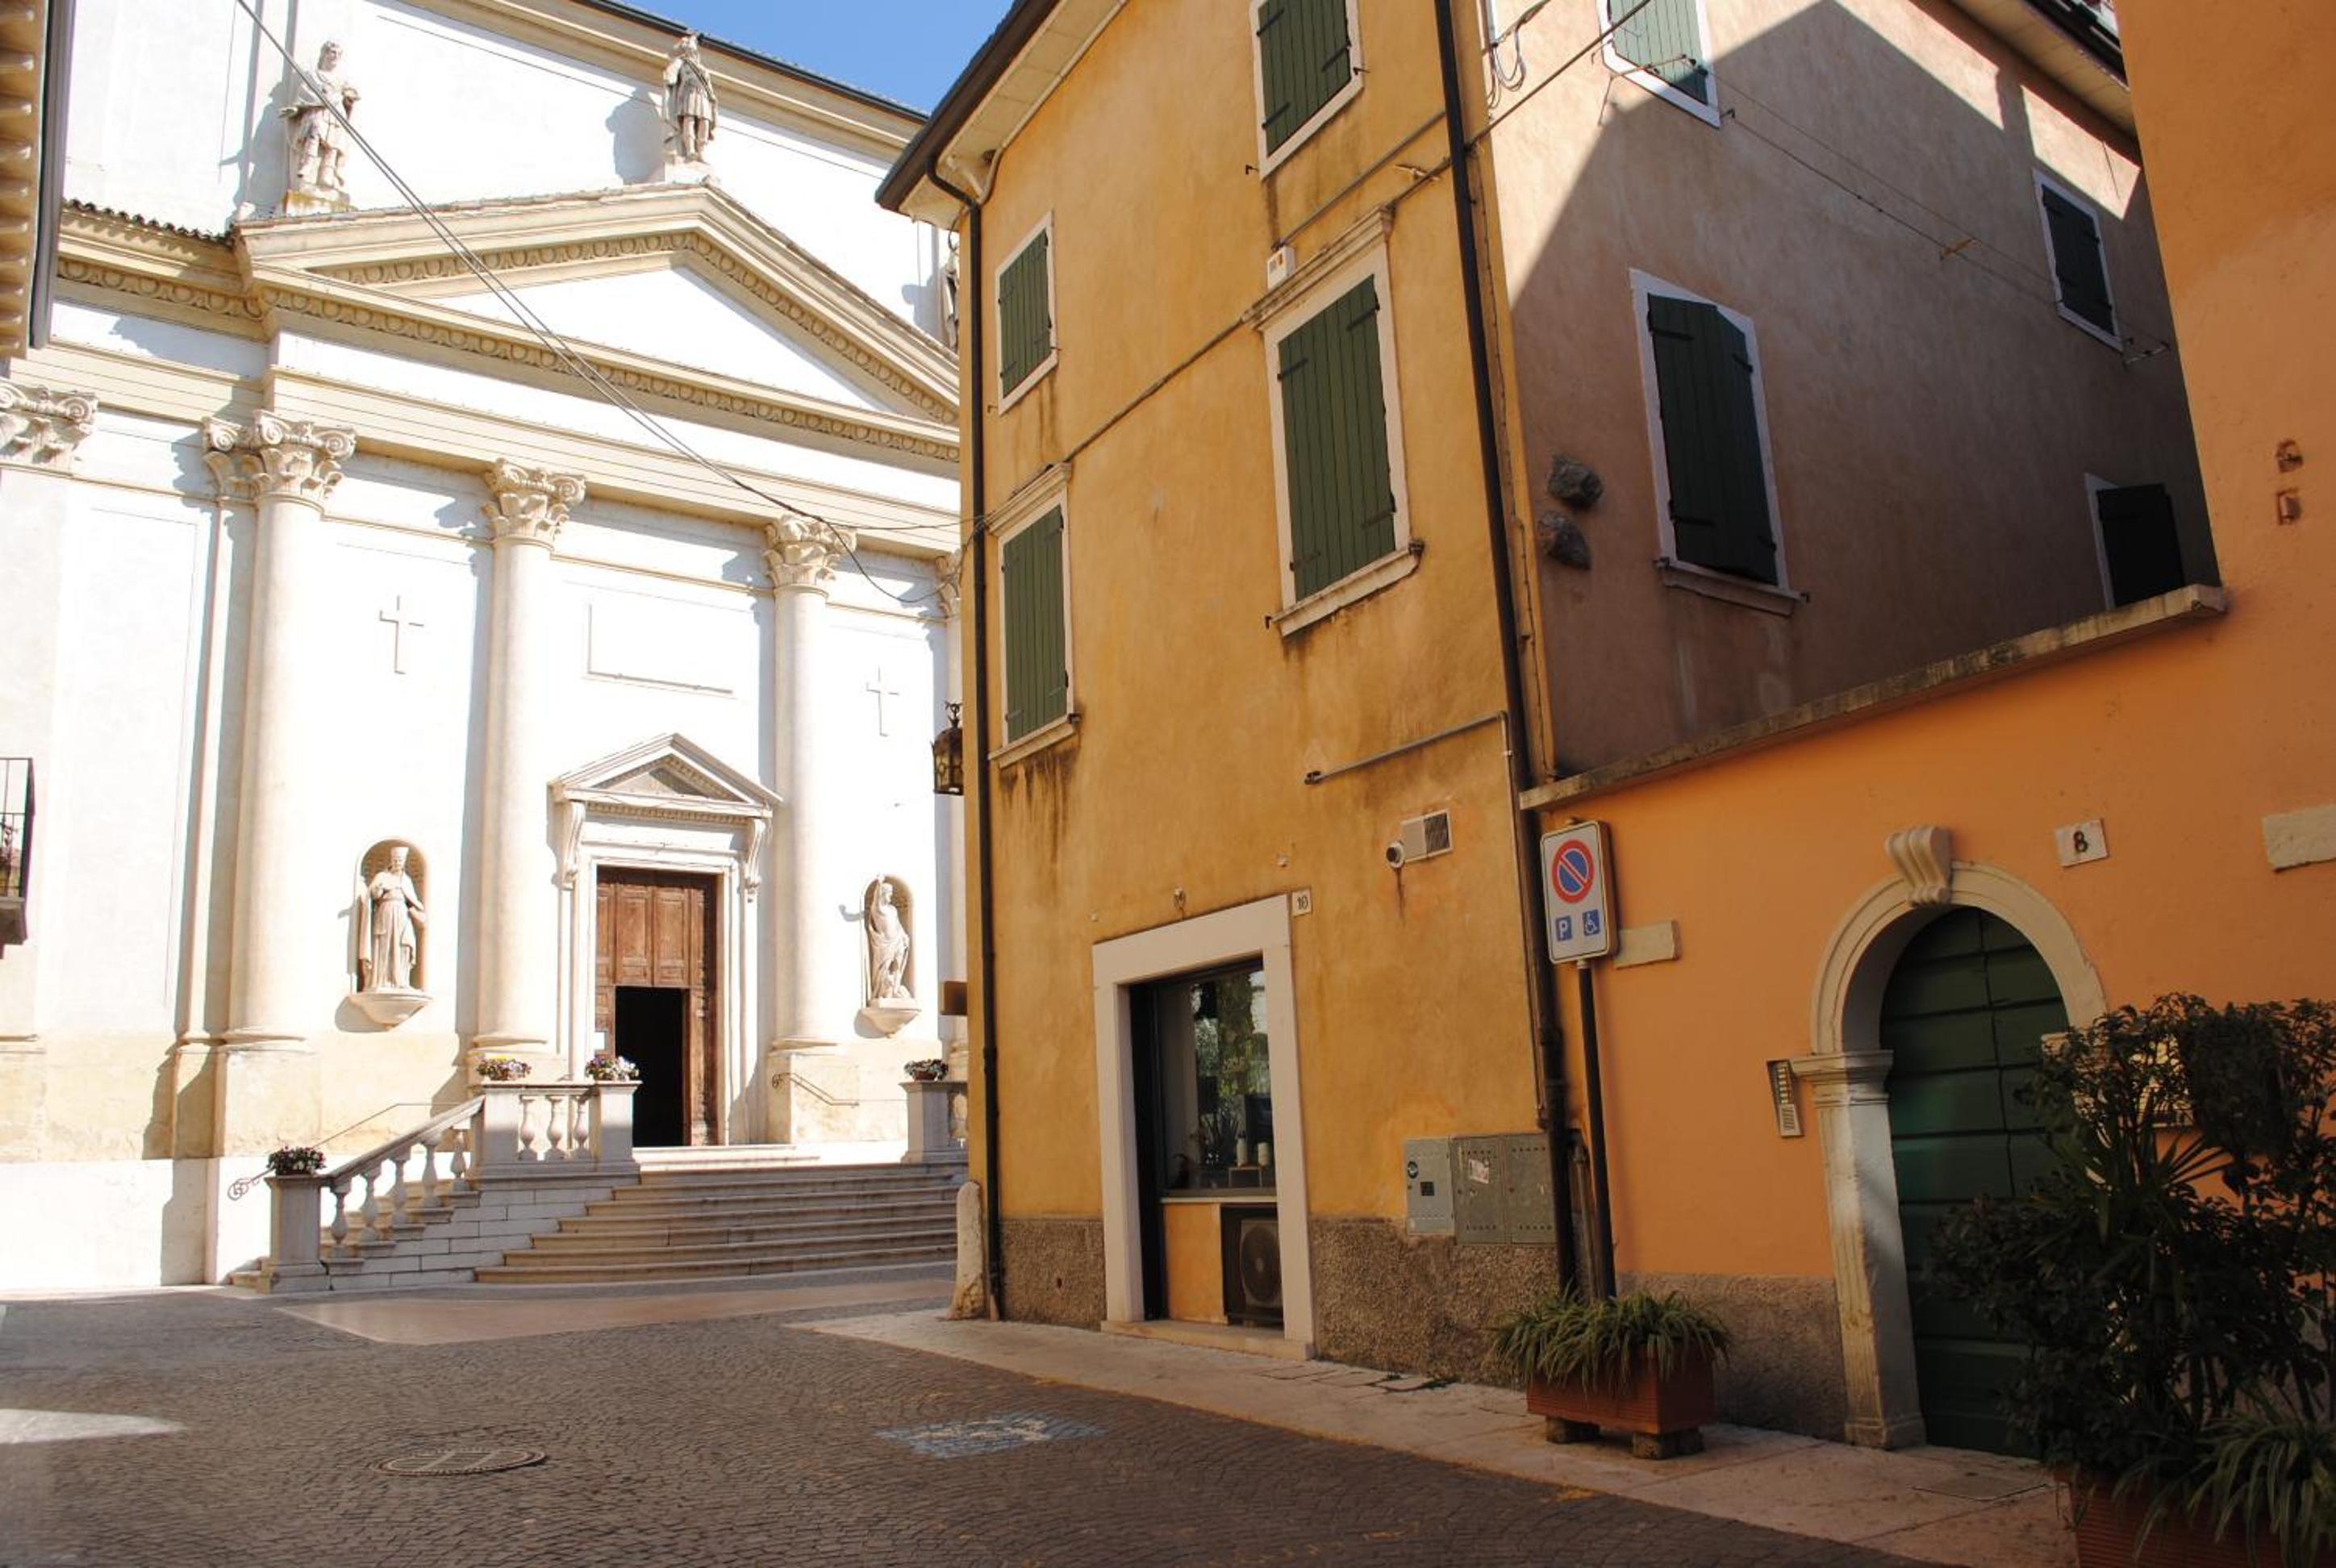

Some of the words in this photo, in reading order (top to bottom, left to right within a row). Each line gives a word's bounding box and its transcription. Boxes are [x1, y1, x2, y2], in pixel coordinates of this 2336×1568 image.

[2073, 830, 2088, 853] 8
[1297, 895, 1309, 910] 10
[1558, 920, 1568, 939] P
